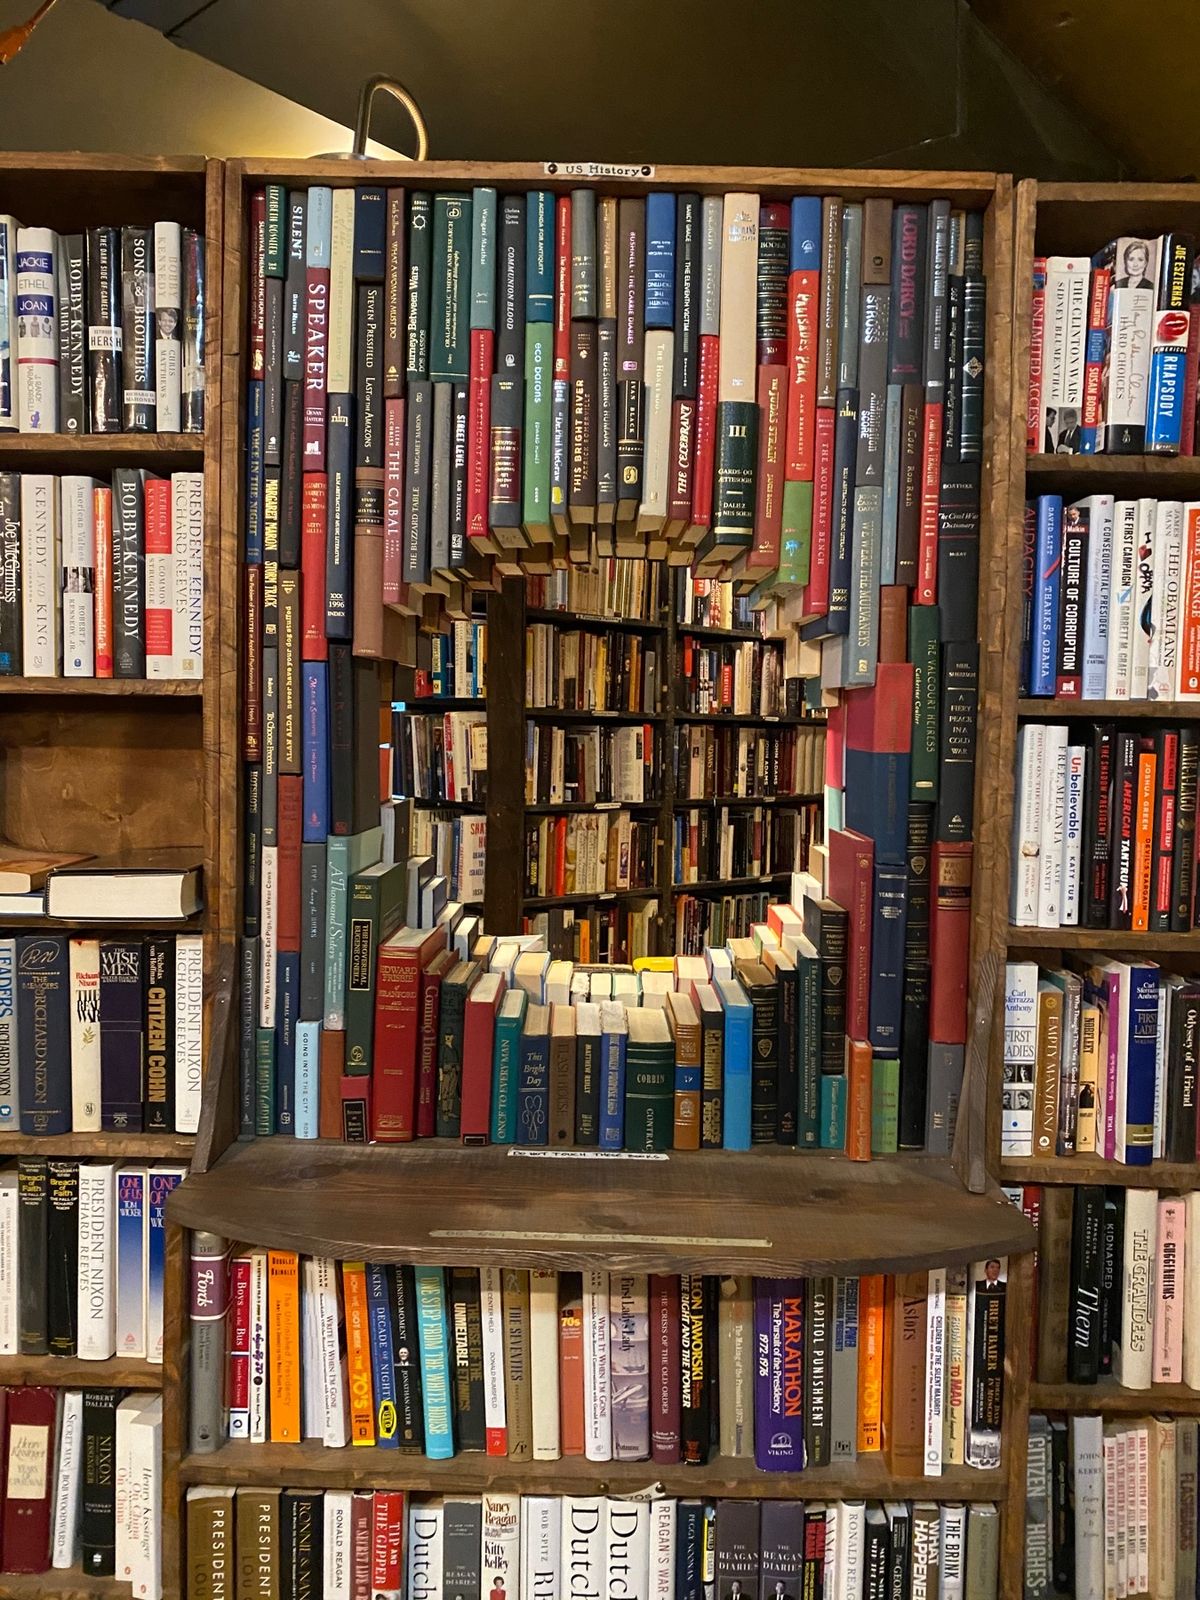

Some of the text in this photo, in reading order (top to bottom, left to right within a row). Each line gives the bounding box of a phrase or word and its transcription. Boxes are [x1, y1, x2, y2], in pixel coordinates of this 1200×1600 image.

[566, 165, 640, 177] US History
[18, 257, 48, 268] JACKIE
[291, 206, 303, 260] SILENT
[18, 278, 48, 289] ETHEL
[19, 300, 48, 311] JOAN
[134, 238, 145, 383] SONS & BROTHERS
[506, 246, 515, 330] COMMUNION BLOOD
[1170, 245, 1187, 307] JOE ESZTERHAS
[69, 258, 83, 397] BOBBY KENNEDY
[91, 335, 122, 347] HERSH
[306, 283, 326, 391] SPEAKER
[366, 290, 378, 368] STEVEN PRESSFIELD
[407, 265, 419, 372] Journeys Between Wars
[1067, 278, 1084, 403] THE CLINTON WARS
[534, 342, 543, 404] eco barons
[1028, 296, 1044, 428] UNLIMITED ACCESS
[1085, 367, 1099, 423] SUSAN BORDO
[1158, 356, 1179, 418] RHAPSODY
[455, 414, 466, 469] STREET LEVEL
[573, 380, 584, 493] THIS BRIGHT RIVER
[677, 403, 692, 494] THE CELEBRANT
[728, 425, 747, 438] III
[35, 486, 47, 567] KENNEDY
[264, 479, 279, 551] MARGARET MARON
[387, 450, 400, 536] THE CABAL
[4, 518, 21, 603] Joe McGinniss
[121, 482, 139, 640] BOBBY KENNEDY
[176, 479, 188, 615] RICHARD REEVES
[189, 480, 201, 657] PRESIDENT KENNEDY
[264, 560, 278, 608] STORM TRACK
[1121, 506, 1135, 587] THE FIRST CAMPAIGN
[36, 603, 48, 646] KING
[1063, 539, 1082, 670] CULTURE OF CORRUPTION
[1163, 542, 1181, 668] THE OBAMIANS
[925, 640, 937, 752] THE VALCOURT HEIRESS
[1068, 756, 1082, 839] Unbelievable
[1119, 780, 1132, 890] AMERICAN TANTRUM
[102, 952, 138, 965] WISE
[102, 964, 138, 976] MEN
[177, 948, 186, 1064] RICHARD REEVES
[188, 949, 201, 1093] PRESIDENT NIXON
[1183, 1009, 1197, 1050] Odyssey
[149, 987, 166, 1103] CITIZEN COHN
[524, 1064, 545, 1074] Bright
[526, 1076, 542, 1086] Day
[527, 1052, 544, 1061] This
[637, 1073, 665, 1083] CORBIN
[1185, 1051, 1196, 1063] of
[1183, 1075, 1195, 1107] Friend
[50, 1178, 77, 1186] Breach
[91, 1178, 105, 1320] PRESIDENT NIXON
[1104, 1223, 1114, 1289] KIDNAPPED
[197, 1269, 214, 1307] Fords
[561, 1317, 581, 1327] 70s
[618, 1277, 635, 1352] First Lady's Lady
[1074, 1285, 1099, 1348] Them
[1130, 1229, 1148, 1352] THE GRANDEES
[420, 1276, 449, 1435] ONE STEP FROM THE WHITE HOUSE
[454, 1302, 469, 1368] UNMELTABLE
[681, 1273, 691, 1408] THE RIGHT AND THE POWER
[689, 1274, 704, 1381] LEON JAWORSKI
[758, 1333, 769, 1377] 1972-1976
[771, 1302, 783, 1414] The Pursuit of the Presidency
[784, 1296, 802, 1417] MARATHON
[811, 1293, 825, 1428] CAPITOL PUNISHMENT
[99, 1435, 111, 1485] NIXON
[375, 1502, 388, 1584] THE GIPPER
[389, 1521, 401, 1566] TIP AND
[485, 1497, 510, 1515] Nancy
[485, 1511, 517, 1527] Reagan
[1026, 1437, 1046, 1588] CITIZEN HUGHES
[258, 1504, 271, 1596] PRESIDENT
[413, 1516, 438, 1600] Dutch
[484, 1541, 505, 1557] Kitty
[484, 1555, 510, 1574] Kelley
[657, 1505, 671, 1593] REAGAN'S WAR
[944, 1518, 961, 1579] THE BRINK
